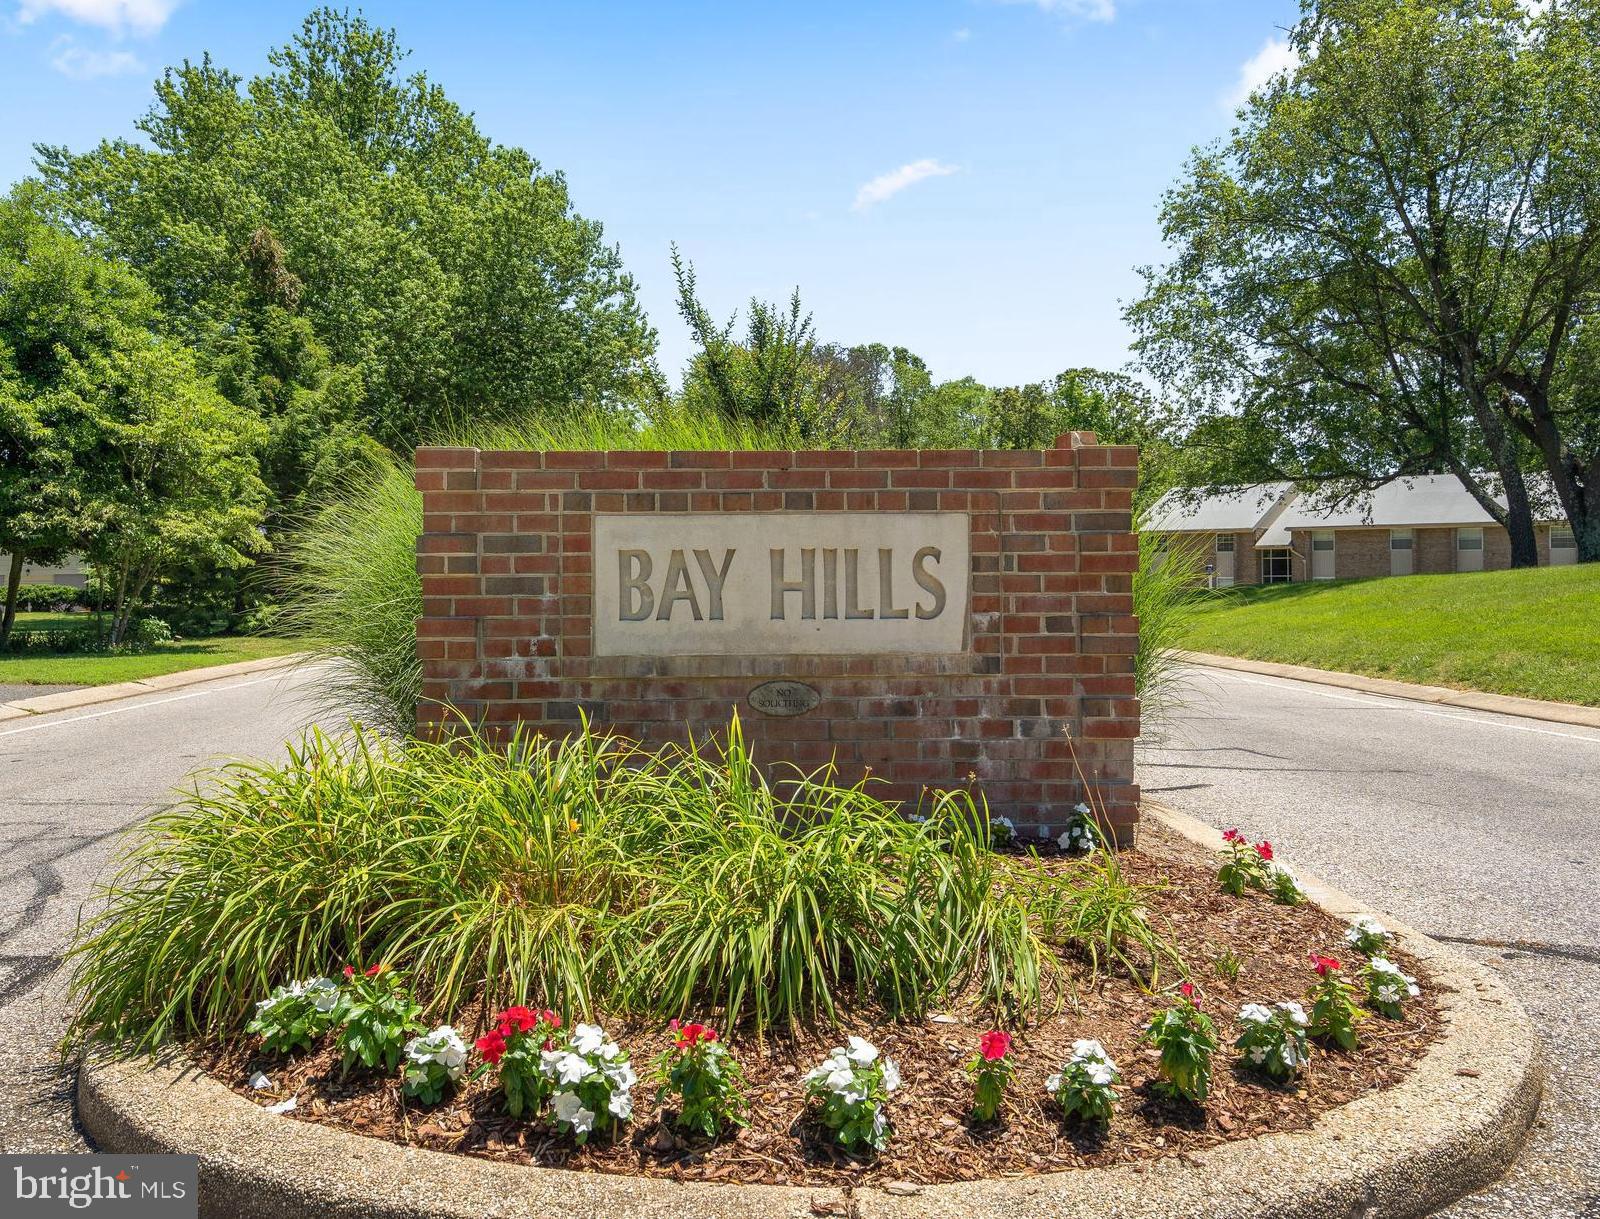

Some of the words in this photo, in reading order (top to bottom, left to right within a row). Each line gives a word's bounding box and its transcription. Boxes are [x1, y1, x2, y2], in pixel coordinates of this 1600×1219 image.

[618, 548, 737, 621] BAY
[769, 546, 947, 620] HILLS
[775, 688, 792, 697] NO
